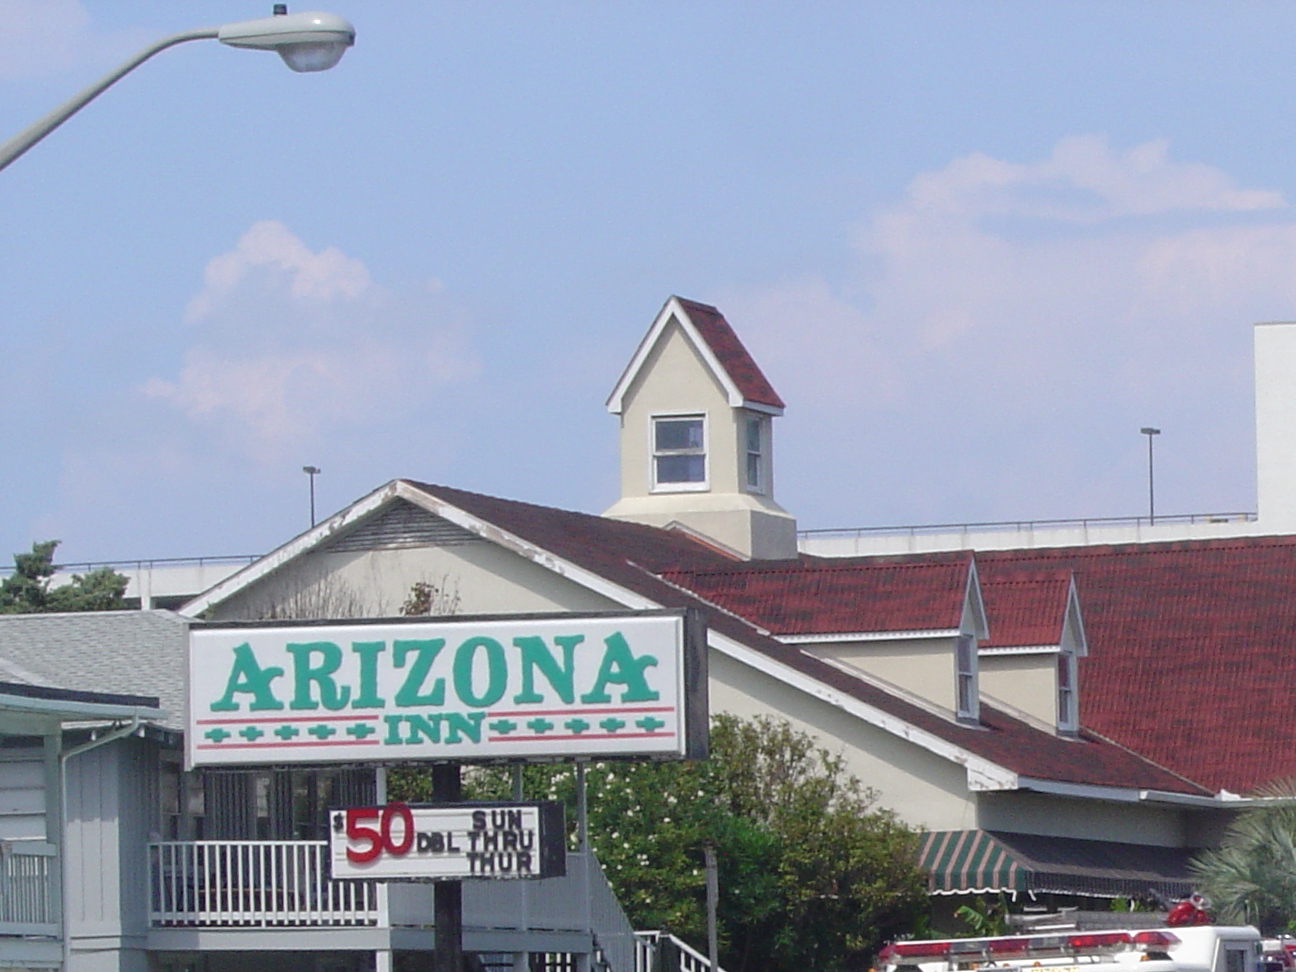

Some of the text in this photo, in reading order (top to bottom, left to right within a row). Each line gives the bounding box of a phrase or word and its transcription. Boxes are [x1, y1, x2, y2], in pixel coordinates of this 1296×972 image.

[210, 631, 660, 711] ARIZONA
[383, 711, 486, 745] INN
[472, 809, 522, 831] SUN
[416, 831, 460, 853] DBL
[467, 830, 533, 852] THRU
[466, 850, 532, 873] THUR
